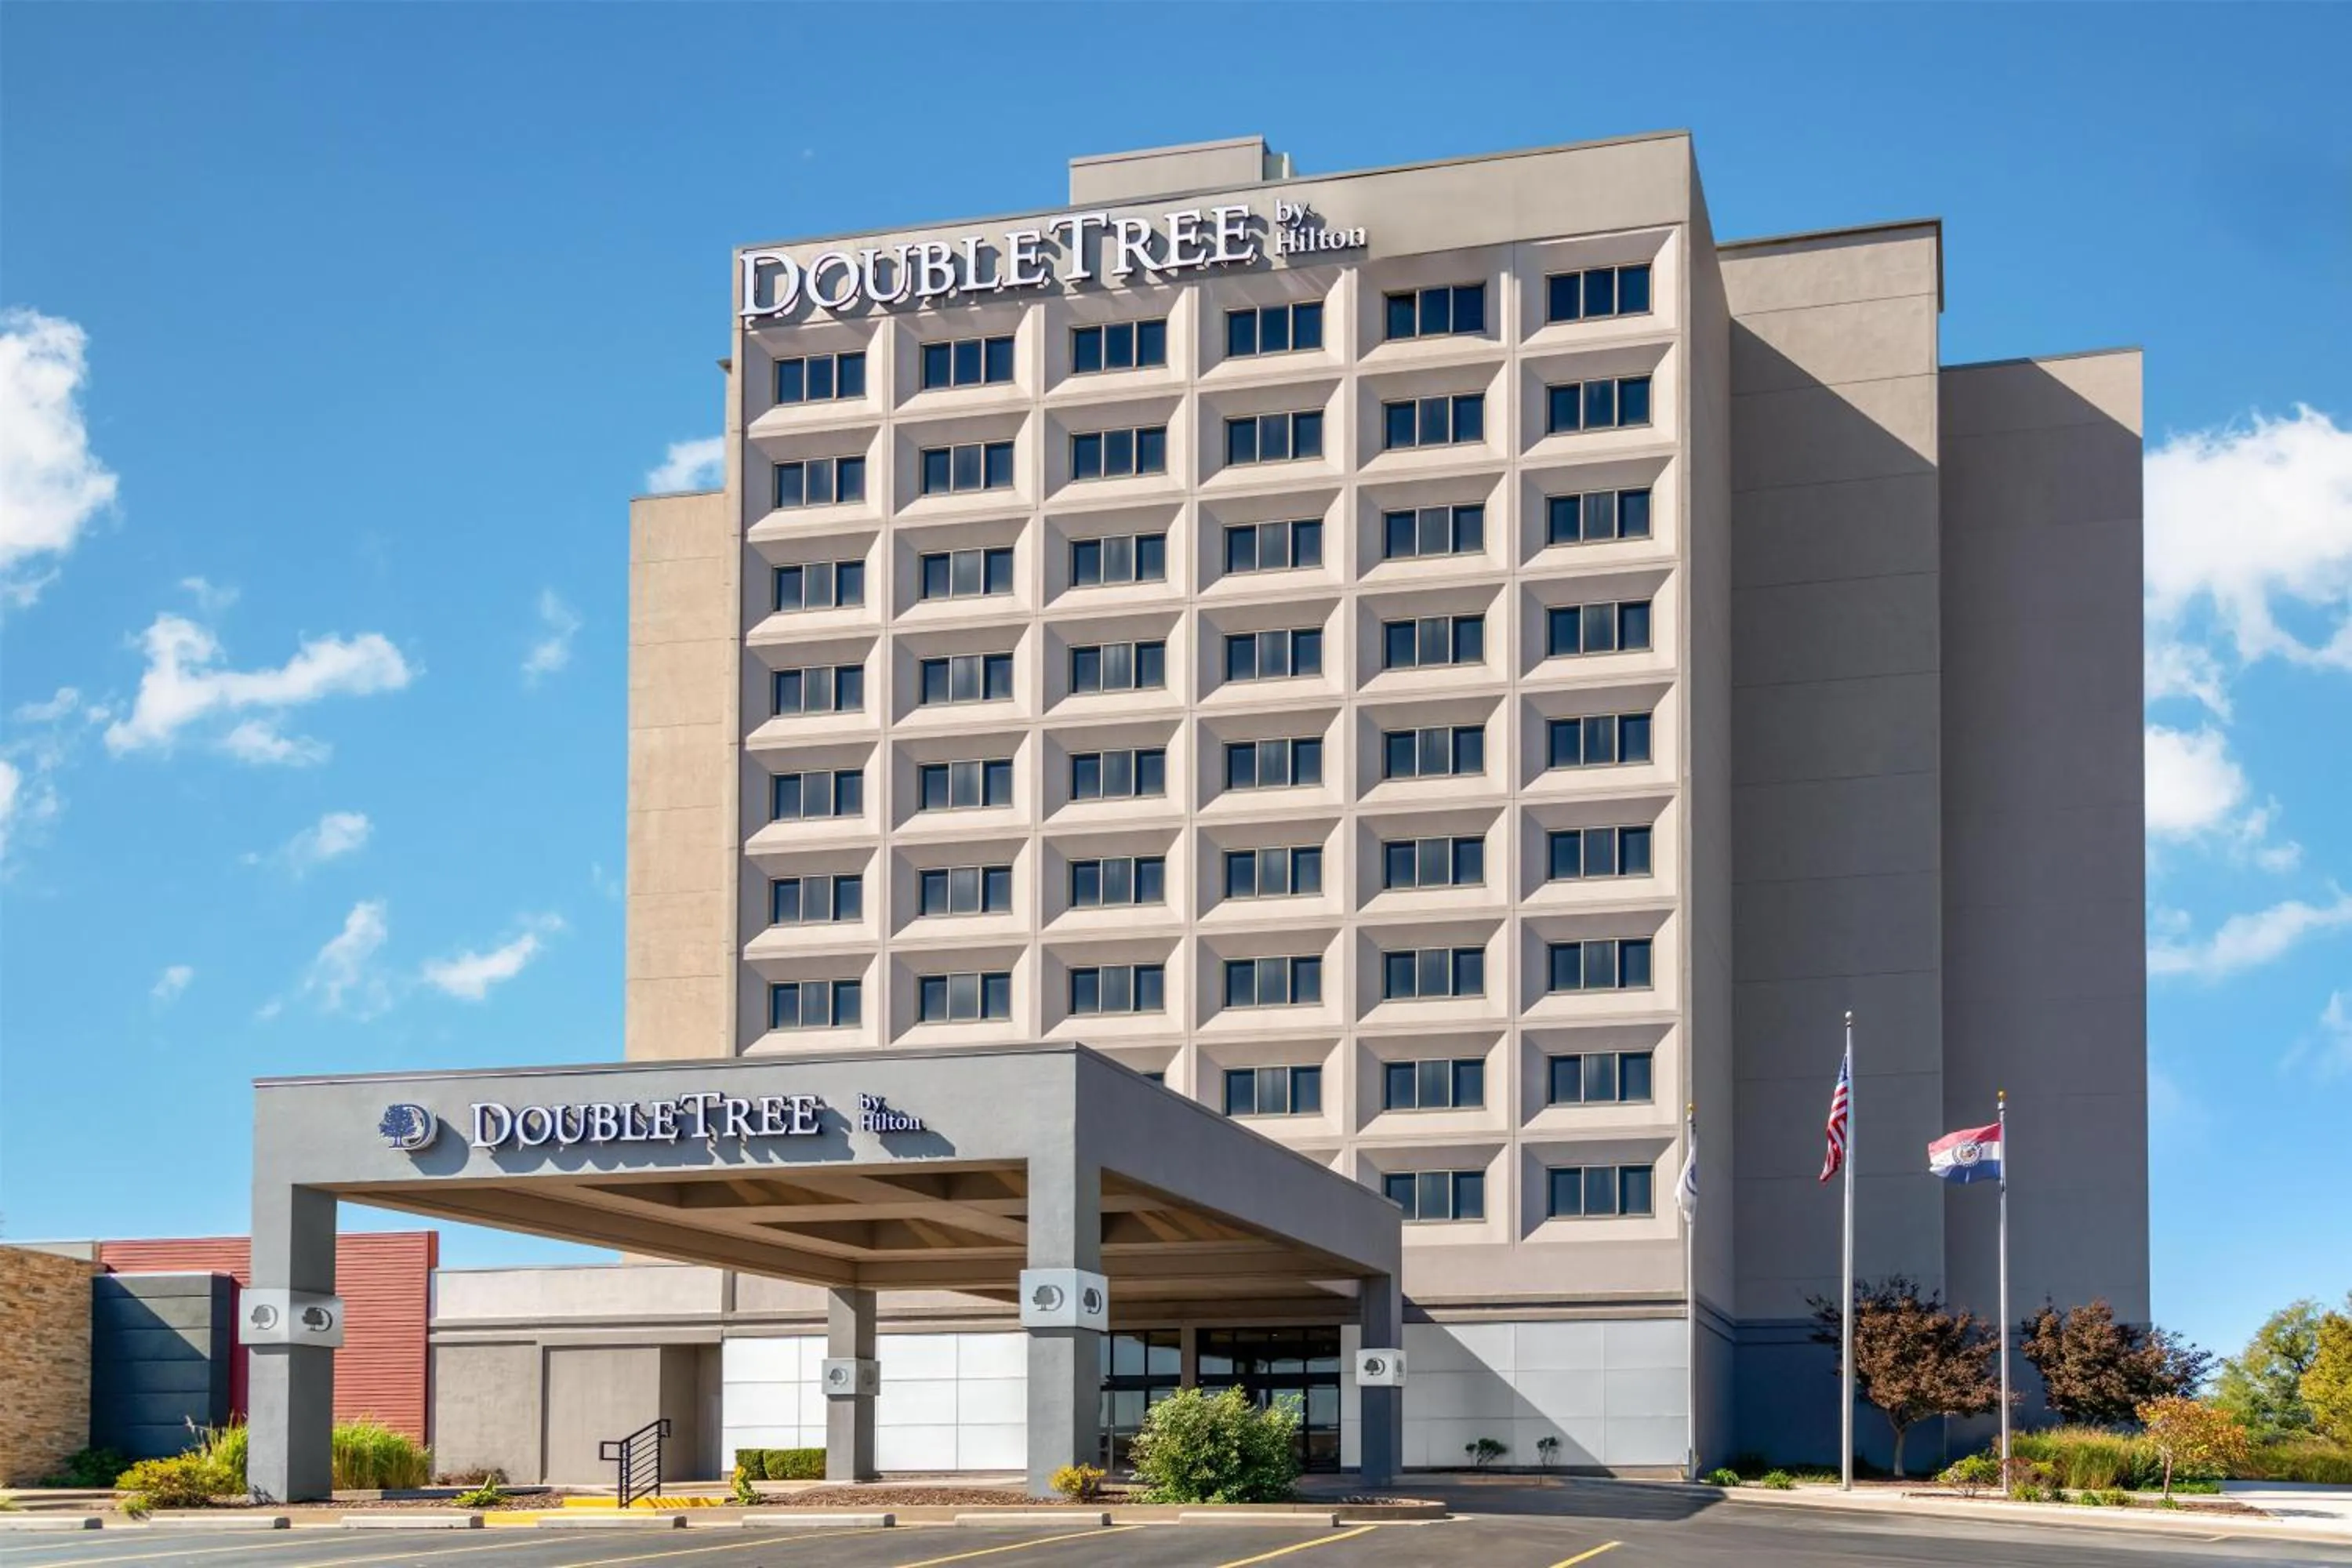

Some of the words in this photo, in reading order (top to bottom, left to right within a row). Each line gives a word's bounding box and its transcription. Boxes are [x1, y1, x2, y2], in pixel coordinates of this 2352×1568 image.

[1276, 198, 1309, 227] by
[1276, 226, 1367, 256] Hilton
[739, 204, 1256, 317] DOUBLETREE
[858, 1093, 886, 1112] by
[470, 1092, 820, 1148] DOUBLETREE
[859, 1112, 921, 1133] Hilton
